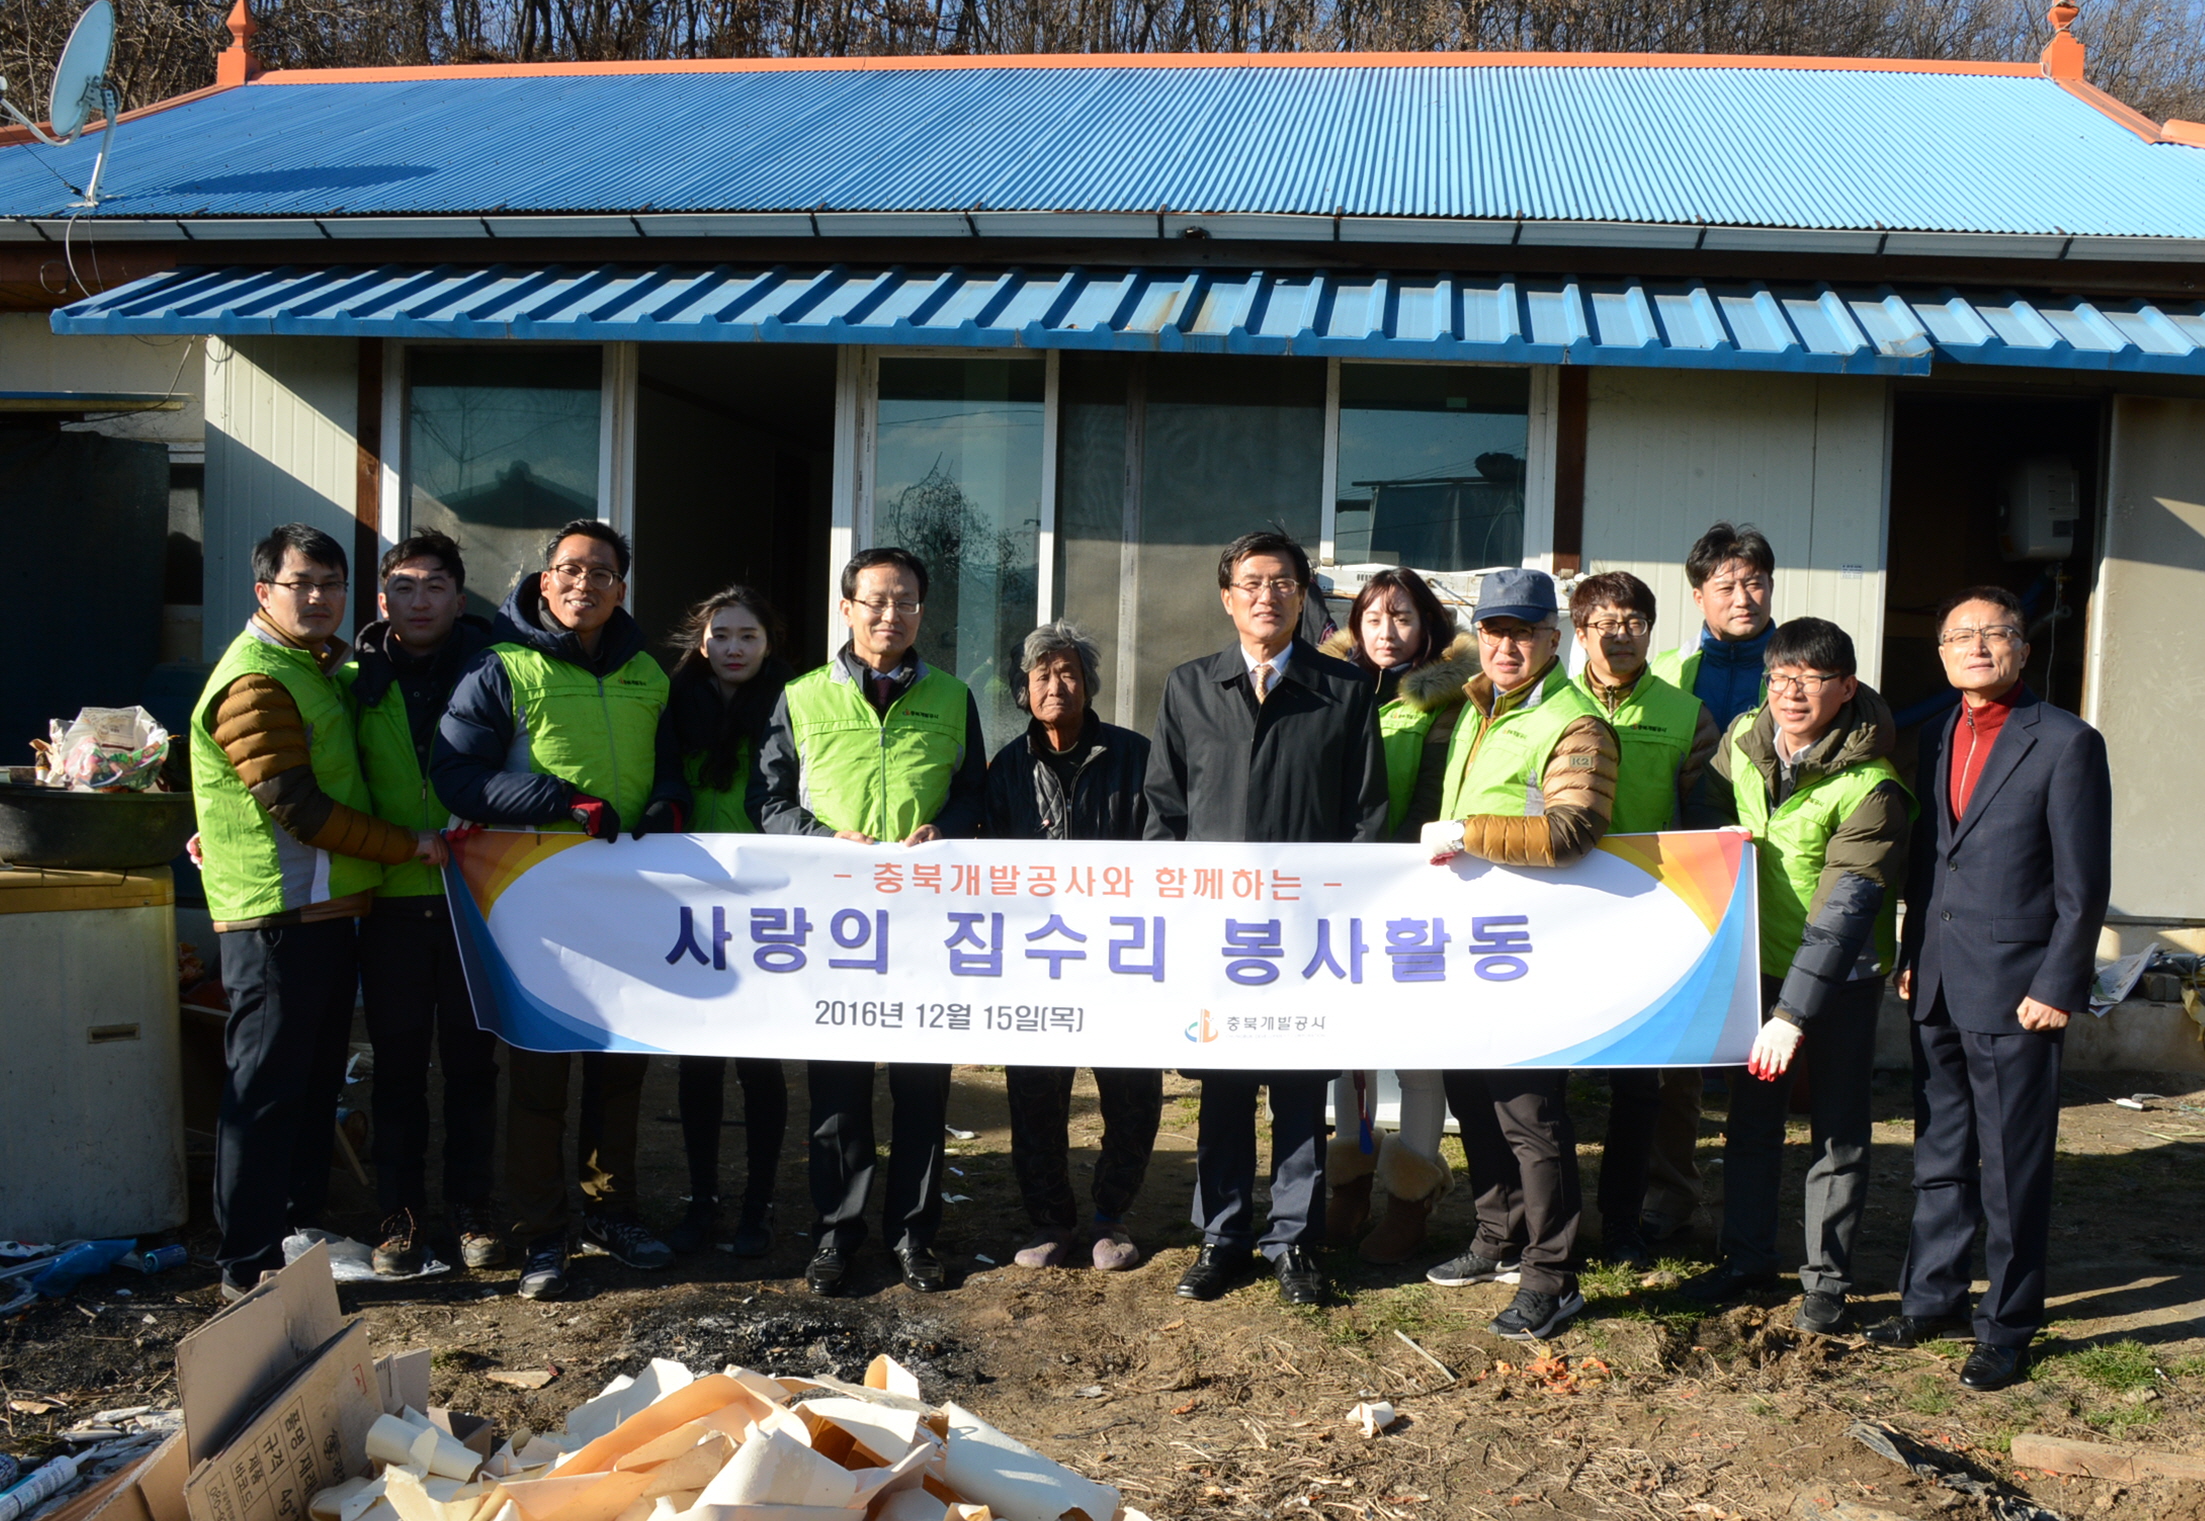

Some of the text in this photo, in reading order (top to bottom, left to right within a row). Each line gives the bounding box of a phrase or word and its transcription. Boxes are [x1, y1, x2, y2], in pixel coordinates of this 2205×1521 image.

[1572, 757, 1590, 766] K2
[873, 862, 1302, 901] 충북개발공사와 함께하는
[665, 906, 1533, 985] 사랑의 집수리 봉사활동
[815, 1000, 1084, 1033] 2016년 12월 15일(목)
[1226, 1016, 1327, 1032] 충북개발공사
[284, 1408, 307, 1450] 품명
[249, 1453, 265, 1486] 제품
[262, 1432, 285, 1475] 규격
[234, 1461, 253, 1509] 바코드
[299, 1452, 321, 1498] 재래
